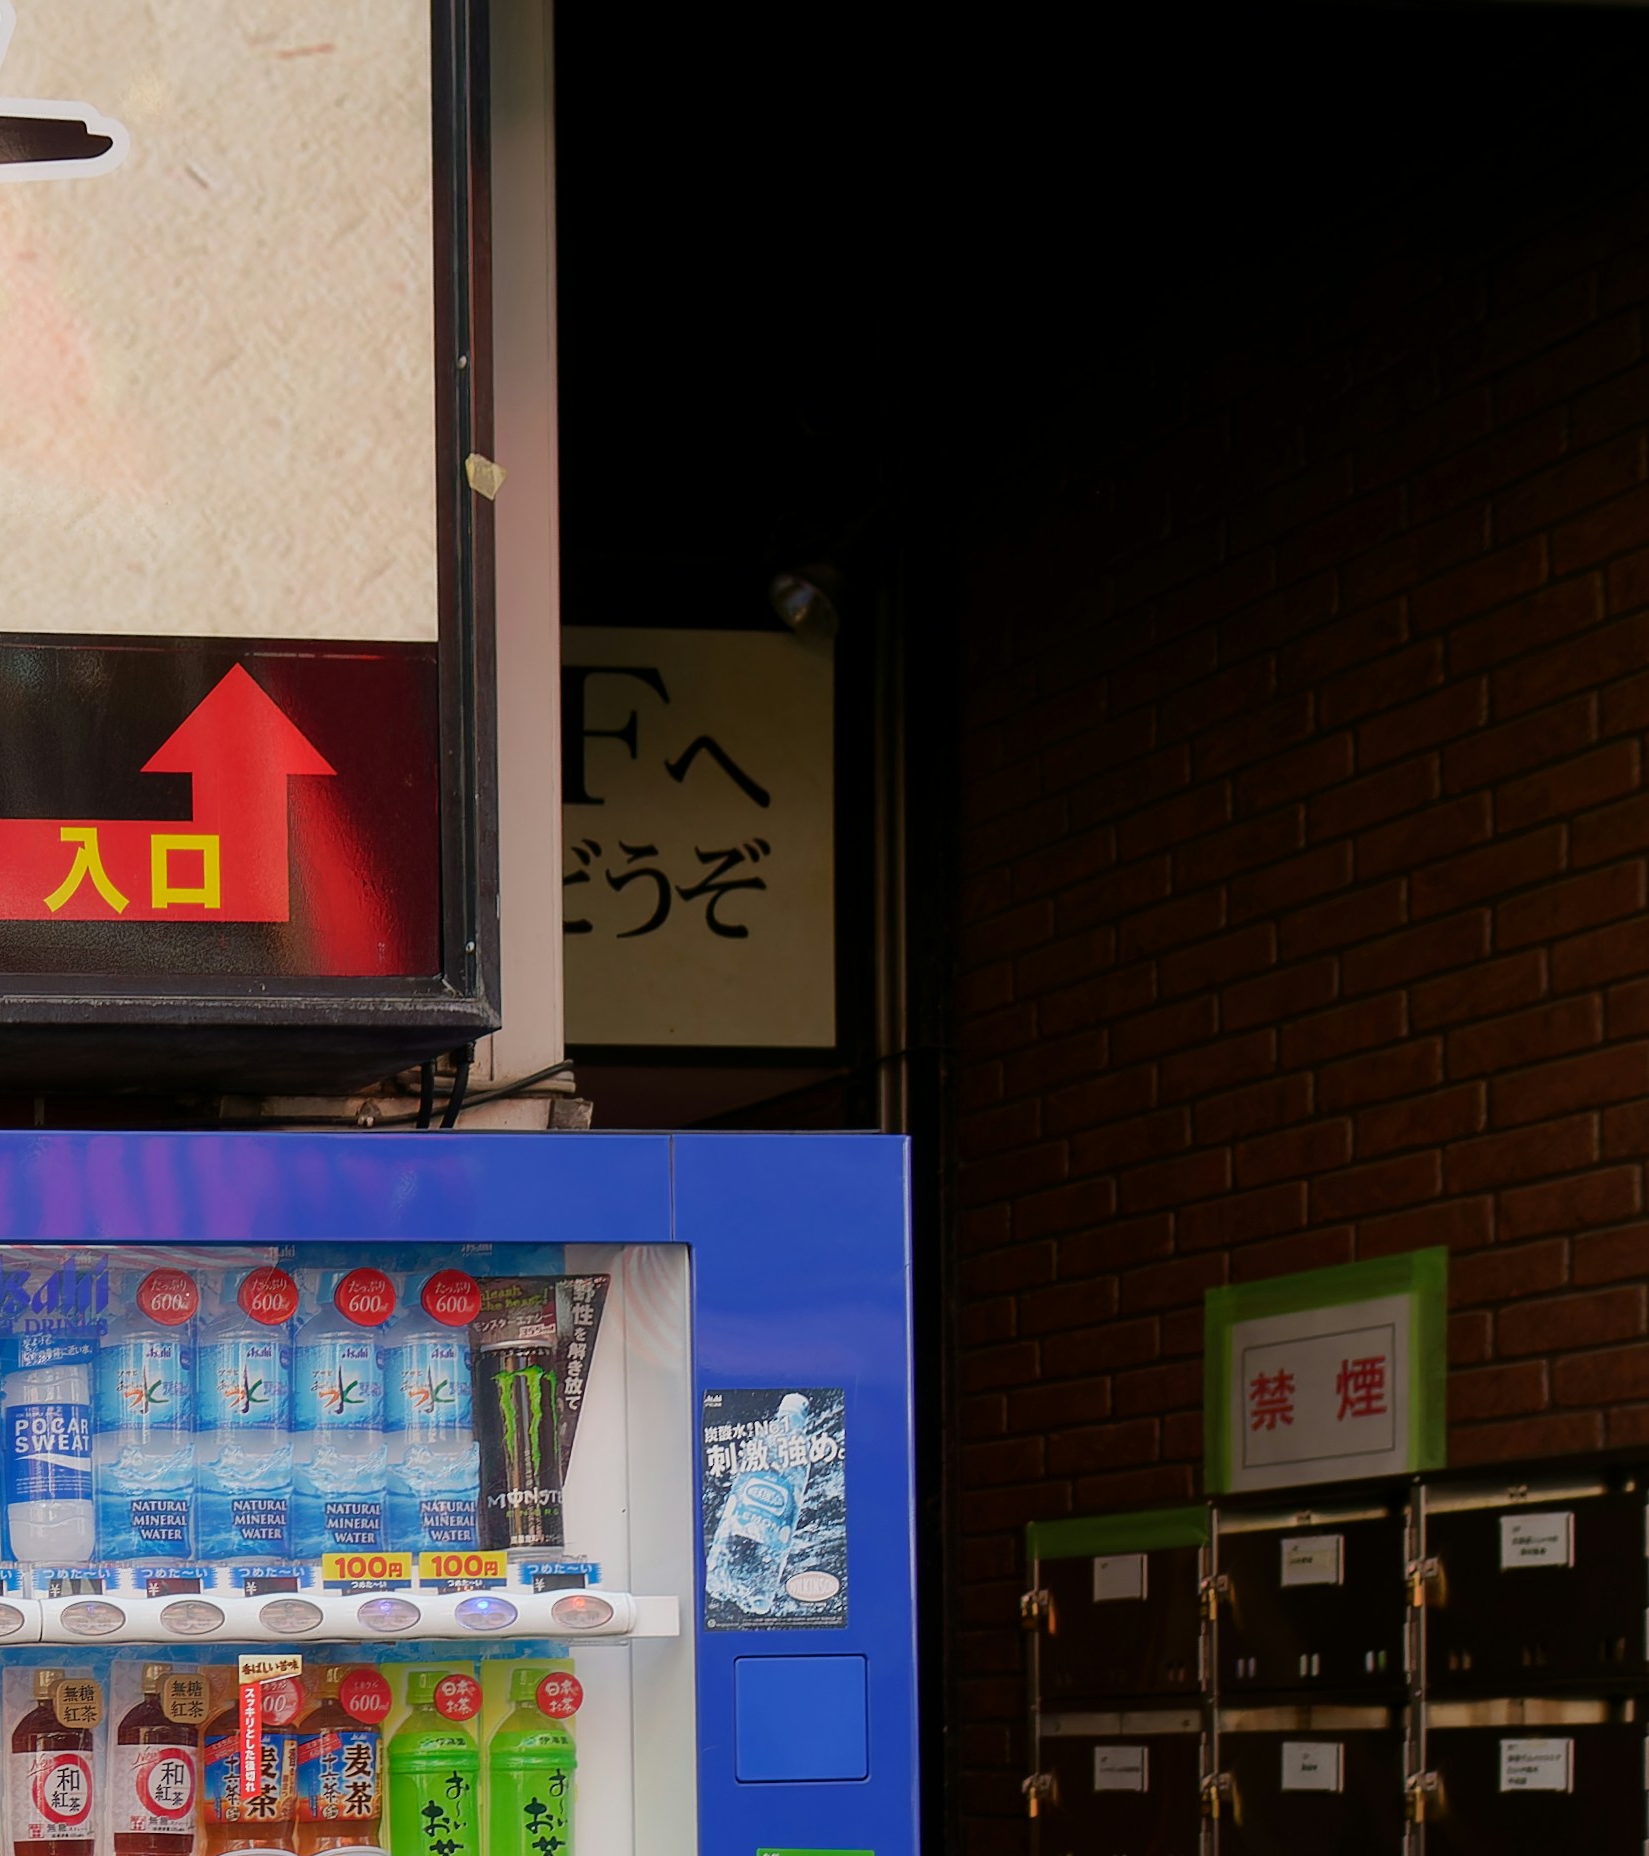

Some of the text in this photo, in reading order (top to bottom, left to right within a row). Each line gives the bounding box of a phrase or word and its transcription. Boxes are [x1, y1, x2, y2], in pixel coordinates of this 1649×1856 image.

[43, 825, 224, 915] 入口
[1248, 1354, 1388, 1431] 禁煙
[131, 1500, 188, 1515] NATURAL
[134, 1514, 187, 1529] MINERAL
[141, 1529, 183, 1542] WATER
[430, 1556, 498, 1579] 100円
